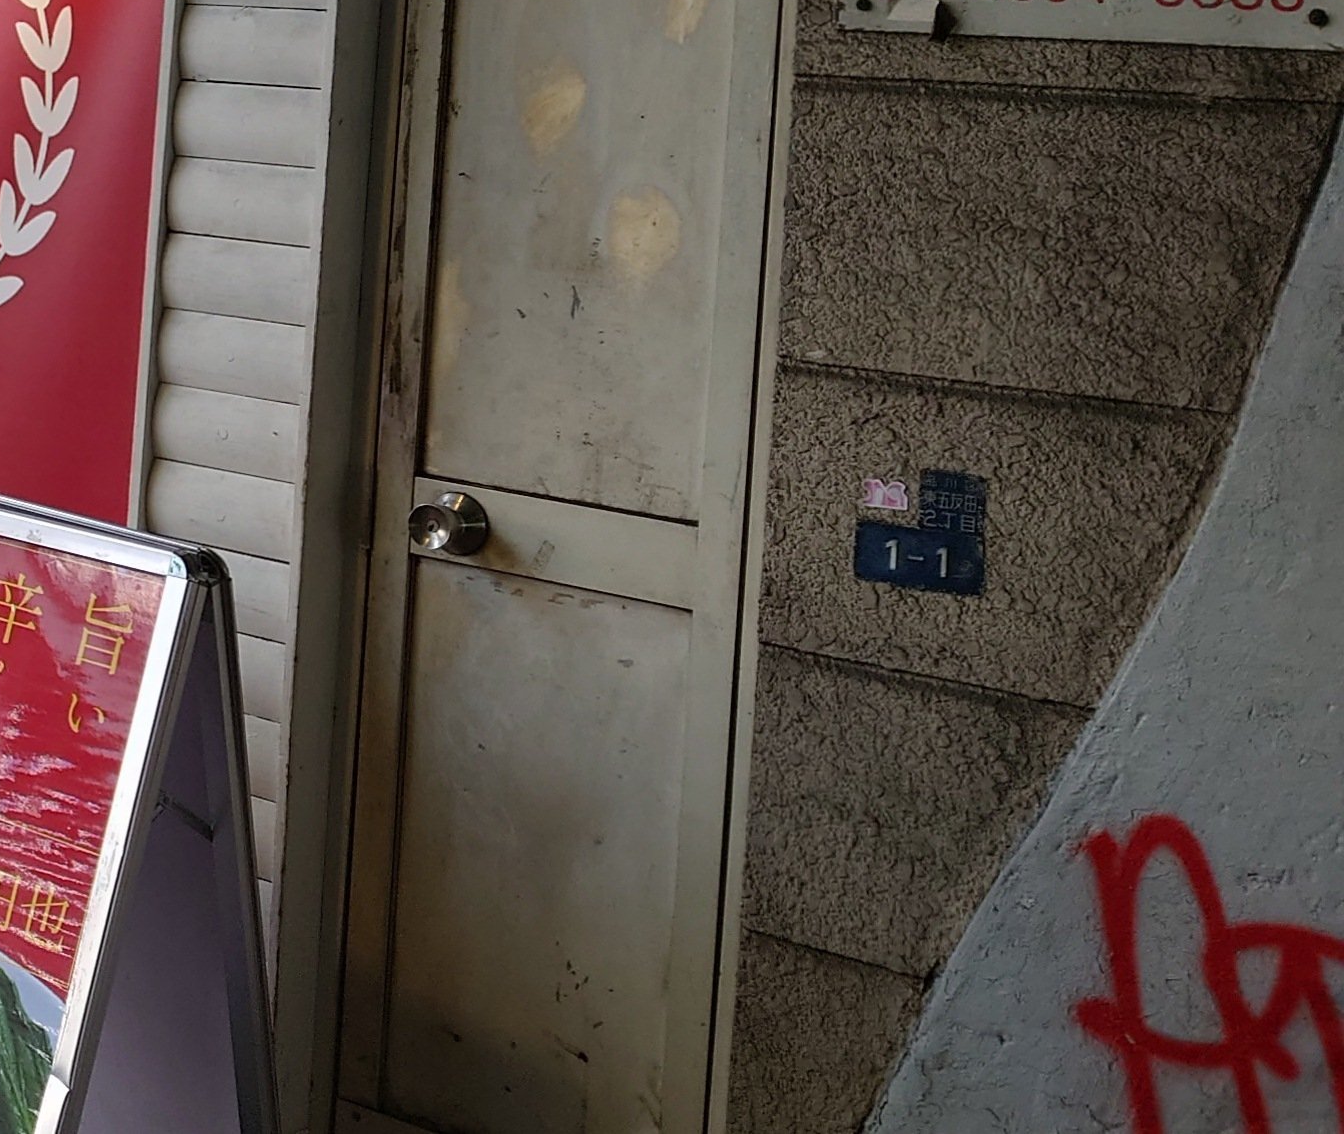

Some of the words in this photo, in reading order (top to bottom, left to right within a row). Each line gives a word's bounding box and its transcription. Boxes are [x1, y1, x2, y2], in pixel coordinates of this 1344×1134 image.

[923, 491, 978, 513] 東五反田
[923, 509, 976, 533] 2丁目
[885, 538, 950, 578] 1-1
[66, 593, 134, 733] 旨い
